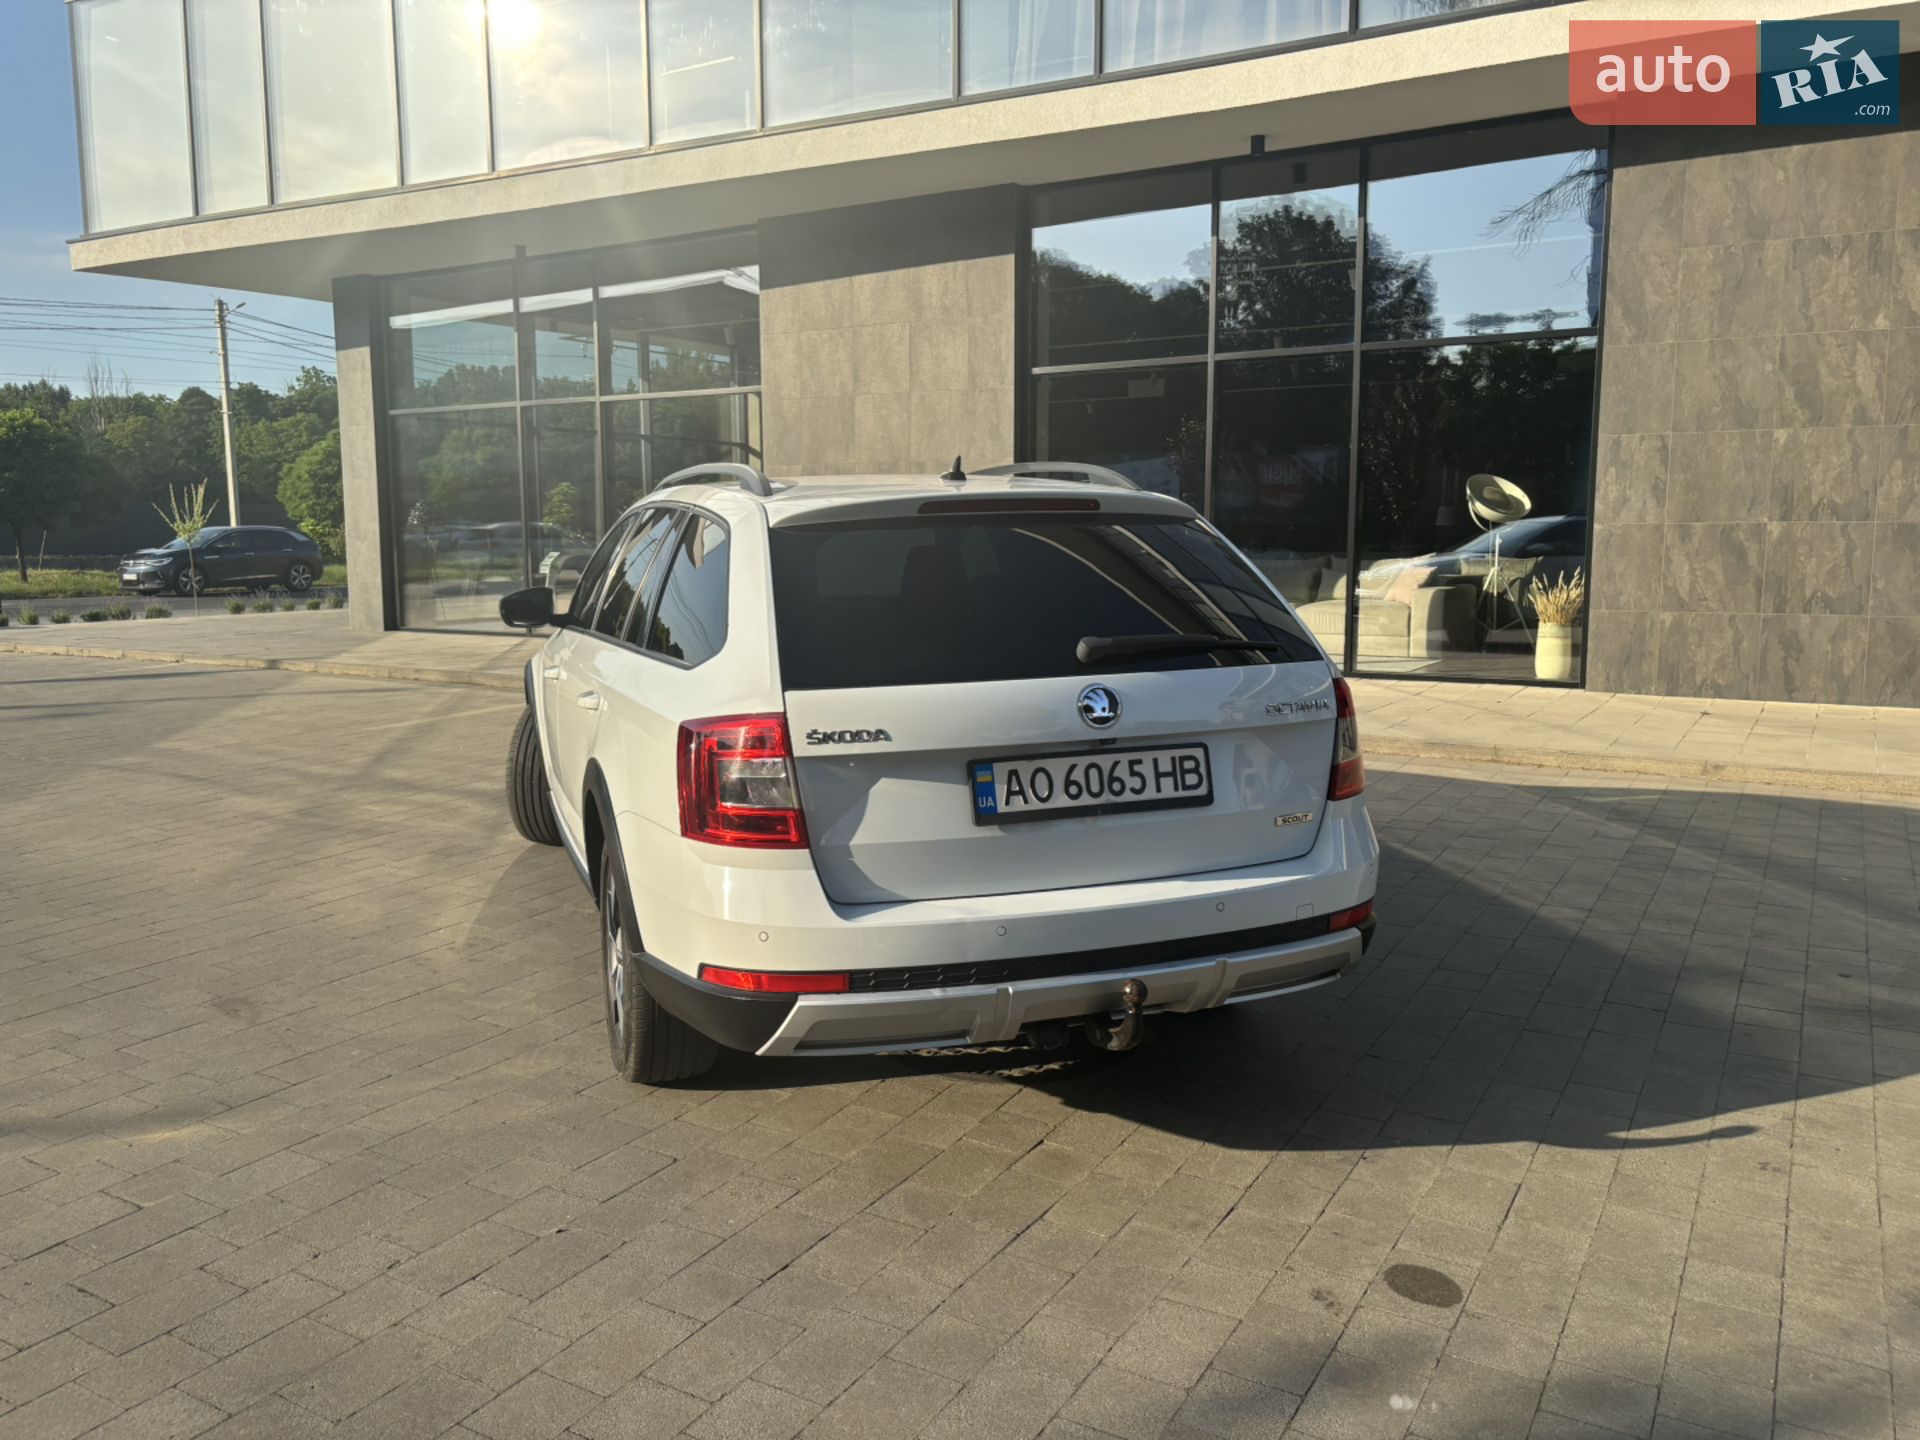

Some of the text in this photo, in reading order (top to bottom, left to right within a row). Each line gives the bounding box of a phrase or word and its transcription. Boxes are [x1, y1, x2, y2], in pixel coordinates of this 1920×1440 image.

[1266, 700, 1330, 715] OCTAVIA
[806, 729, 892, 745] ŠKODA
[1004, 754, 1204, 807] AO 6065 HB
[978, 795, 996, 808] UA
[1282, 814, 1309, 825] SCOUT
